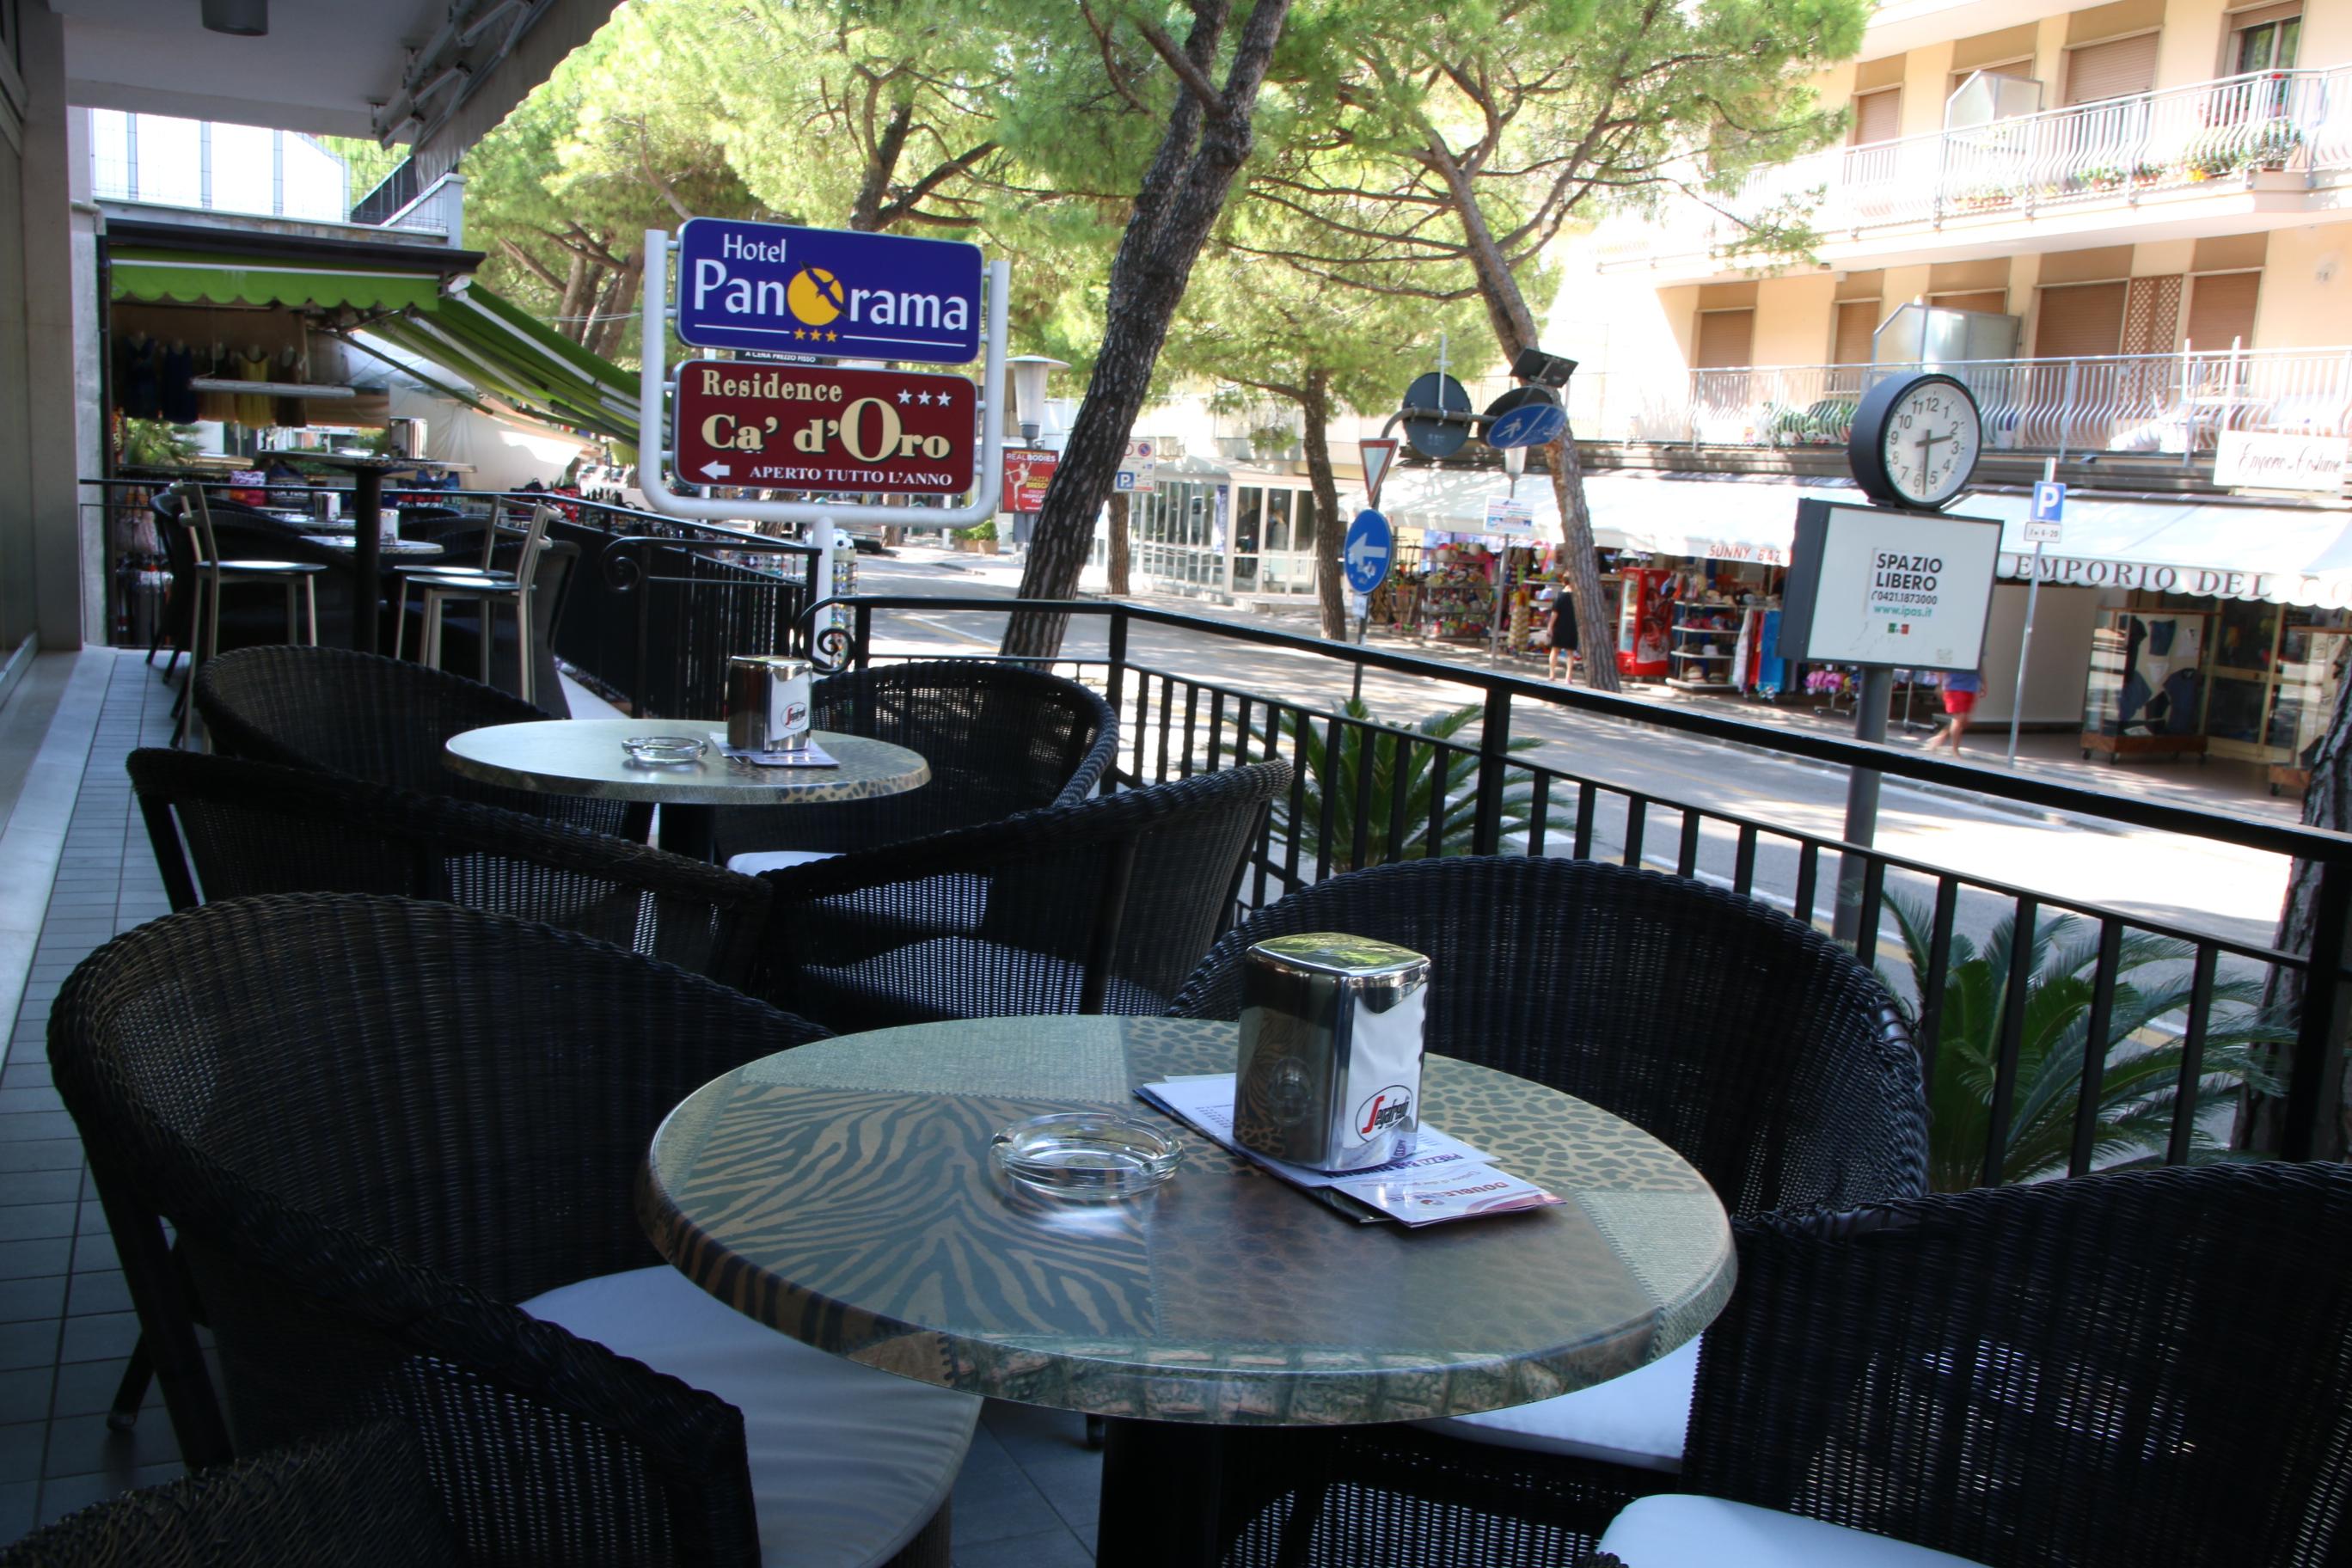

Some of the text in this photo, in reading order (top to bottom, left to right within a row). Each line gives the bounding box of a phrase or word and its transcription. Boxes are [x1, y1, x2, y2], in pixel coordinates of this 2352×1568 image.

[724, 234, 786, 262] Hotel
[701, 370, 842, 402] Residence
[1912, 400, 1924, 414] 11
[1926, 397, 1939, 412] 12
[1944, 406, 1950, 419] 1
[1899, 414, 1913, 429] 10
[1950, 421, 1958, 435] 2
[701, 397, 951, 462] Ca' d'Oro
[1890, 431, 1899, 444] 9
[1951, 440, 1959, 455] 3
[1027, 453, 1057, 462] BODIES
[1892, 450, 1899, 465] 8
[1901, 466, 1909, 480] 7
[1943, 459, 1951, 472] 4
[750, 466, 952, 487] APERTO TUTTO L'ANNO
[1914, 473, 1921, 487] 6
[1929, 471, 1938, 484] 5
[2037, 486, 2061, 518] P
[1709, 544, 1750, 559] SUNNY
[1876, 553, 1943, 573] SPAZIO
[1875, 572, 1938, 591] LIBERO
[2012, 554, 2177, 590] EMPORIO
[2196, 570, 2272, 597] DEL
